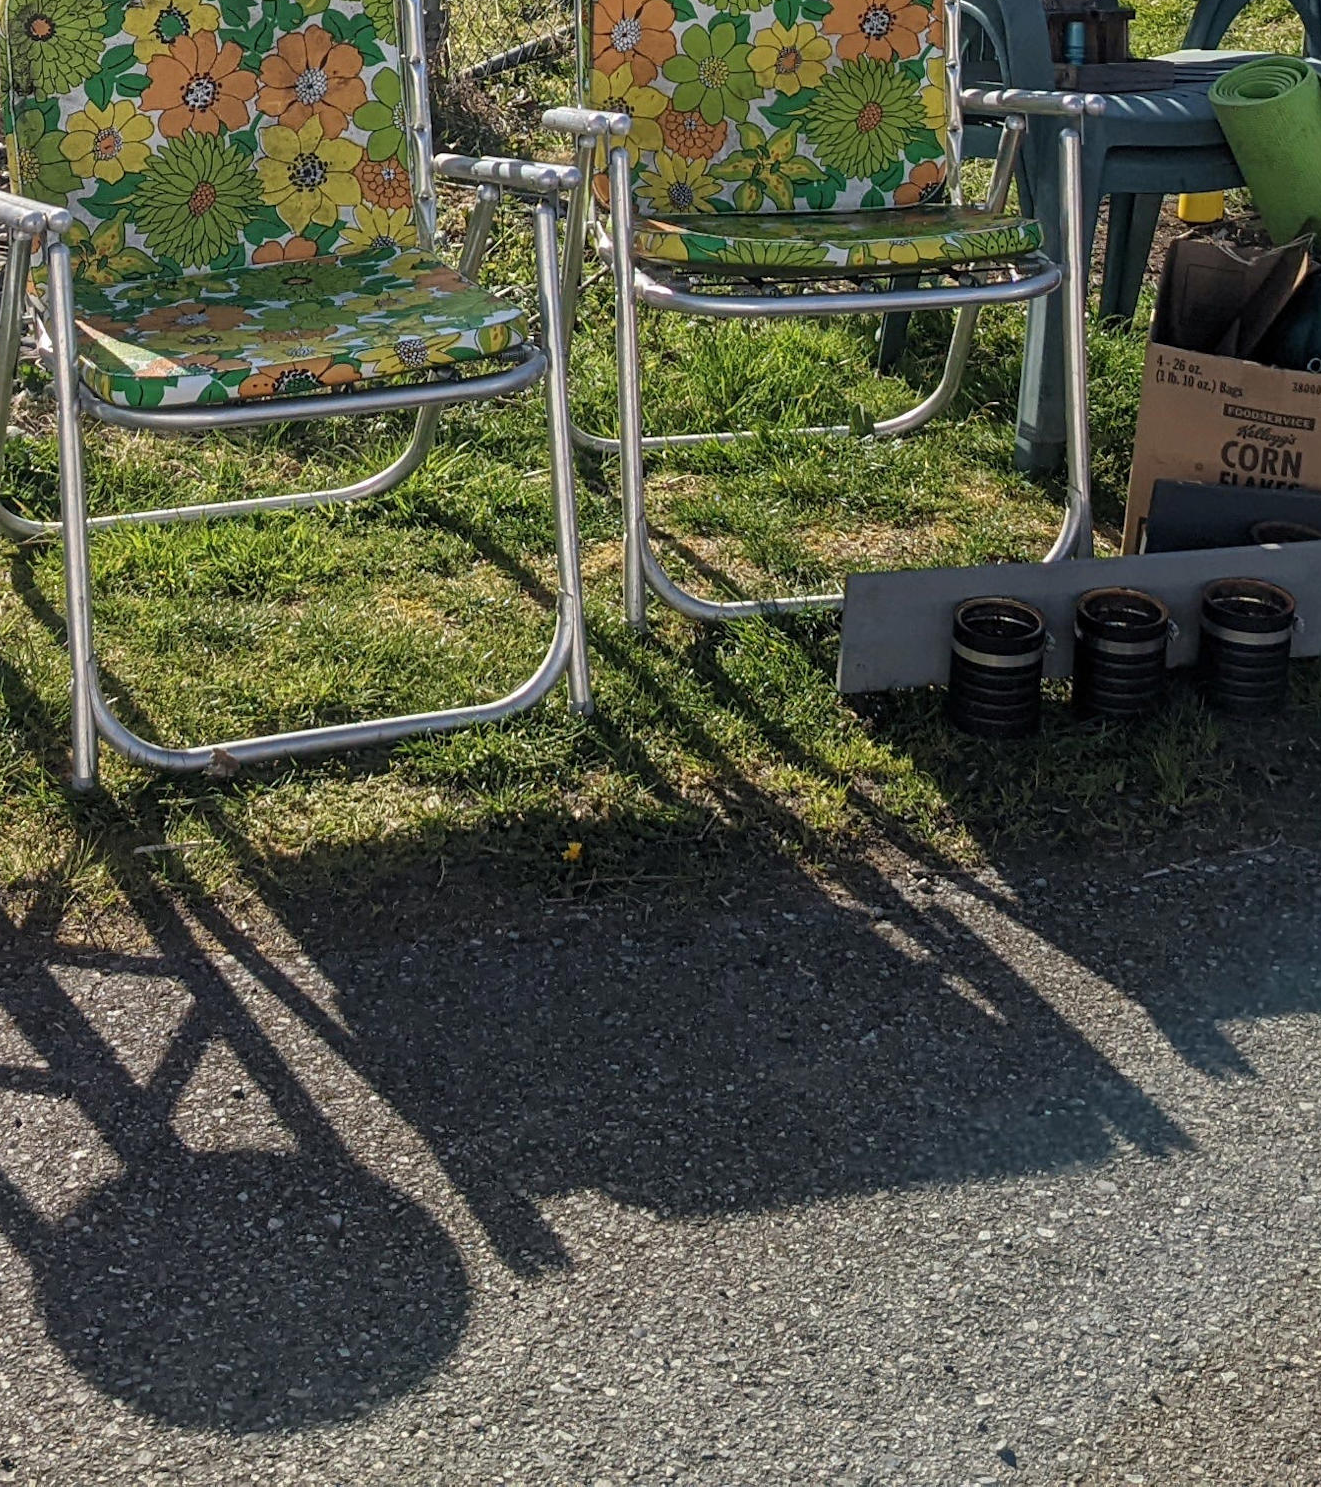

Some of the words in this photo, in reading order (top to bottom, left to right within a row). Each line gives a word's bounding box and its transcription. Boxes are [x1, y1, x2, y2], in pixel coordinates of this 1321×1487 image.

[1156, 355, 1164, 367] 4
[1172, 358, 1186, 372] 26
[1188, 364, 1202, 376] oz.
[1156, 368, 1165, 383] (1
[1167, 371, 1179, 384] lb.
[1181, 374, 1195, 387] 10
[1197, 379, 1217, 394] oz.)
[1219, 381, 1244, 399] Bags
[1292, 382, 1321, 396] 38000
[1226, 406, 1312, 430] FOODSERVICE
[1236, 424, 1297, 449] Kellogg's
[1220, 440, 1303, 479] CORN
